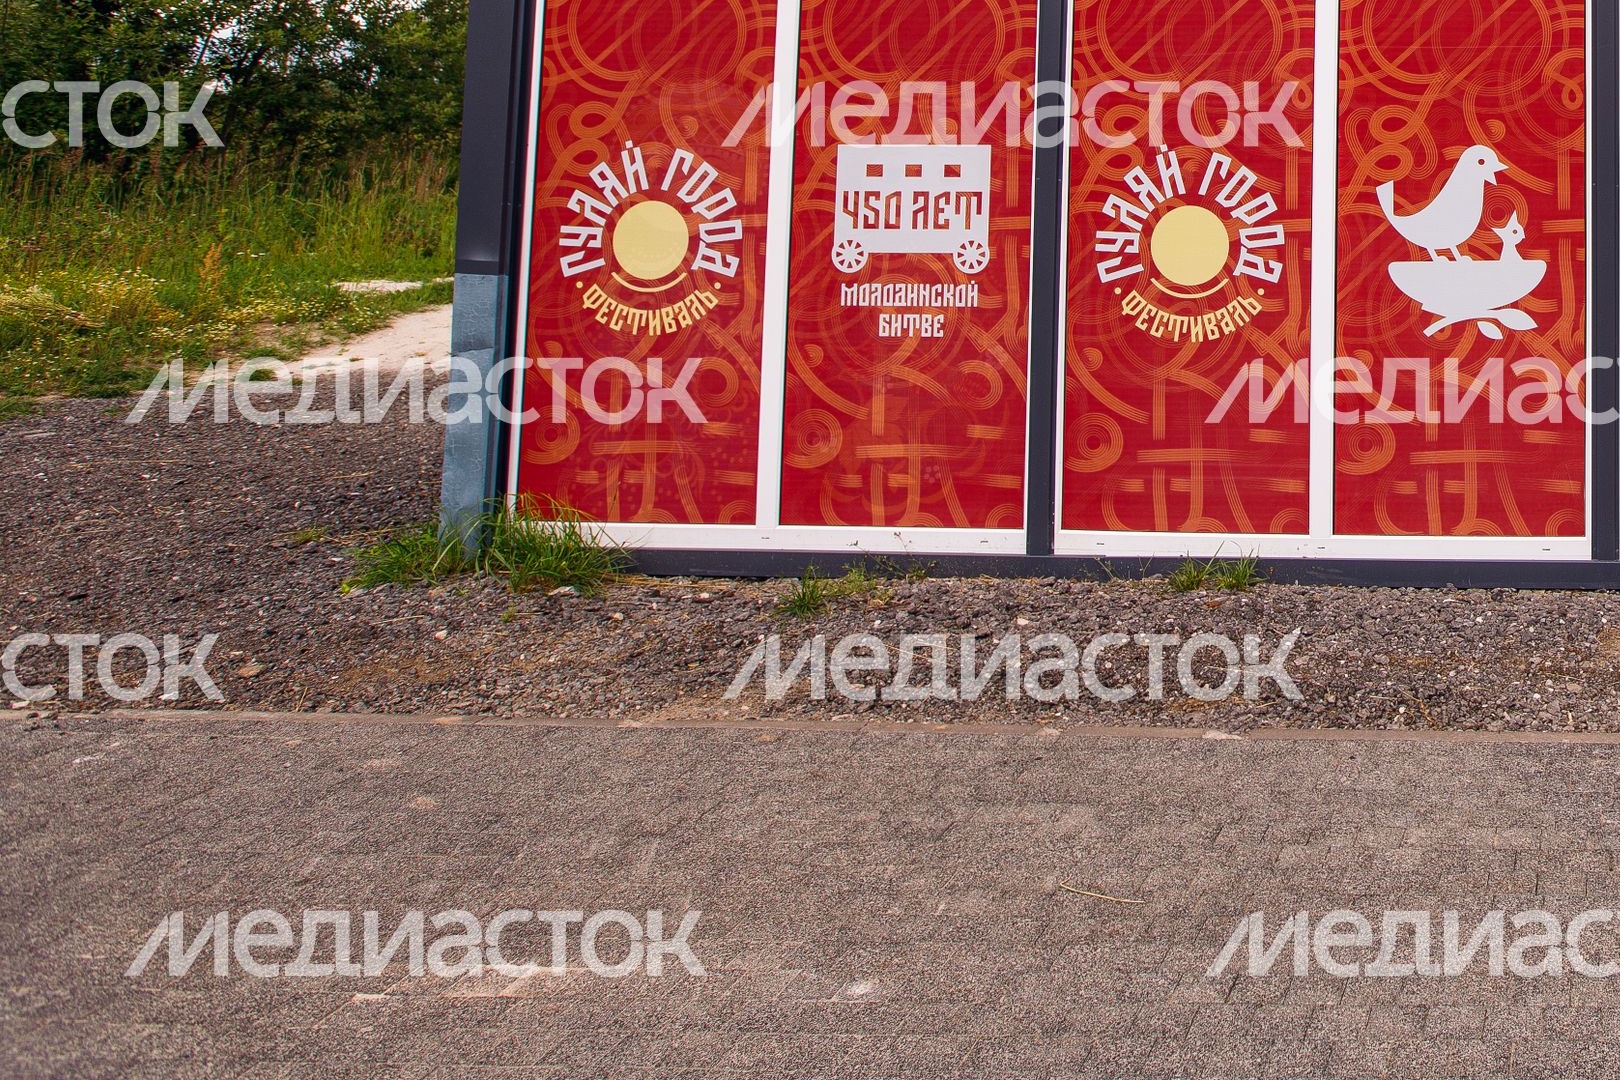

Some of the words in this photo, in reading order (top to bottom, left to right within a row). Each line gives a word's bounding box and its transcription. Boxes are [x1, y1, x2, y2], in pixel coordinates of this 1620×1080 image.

[842, 191, 901, 230] 450
[912, 191, 982, 230] ЛЕТ
[582, 283, 719, 336] ФЕСТИВАЛЬ
[841, 280, 978, 307] МОЛОДИНСКОЙ
[878, 314, 944, 337] БИТВЕ
[1121, 289, 1263, 343] ФЕСТИВАЛЬ
